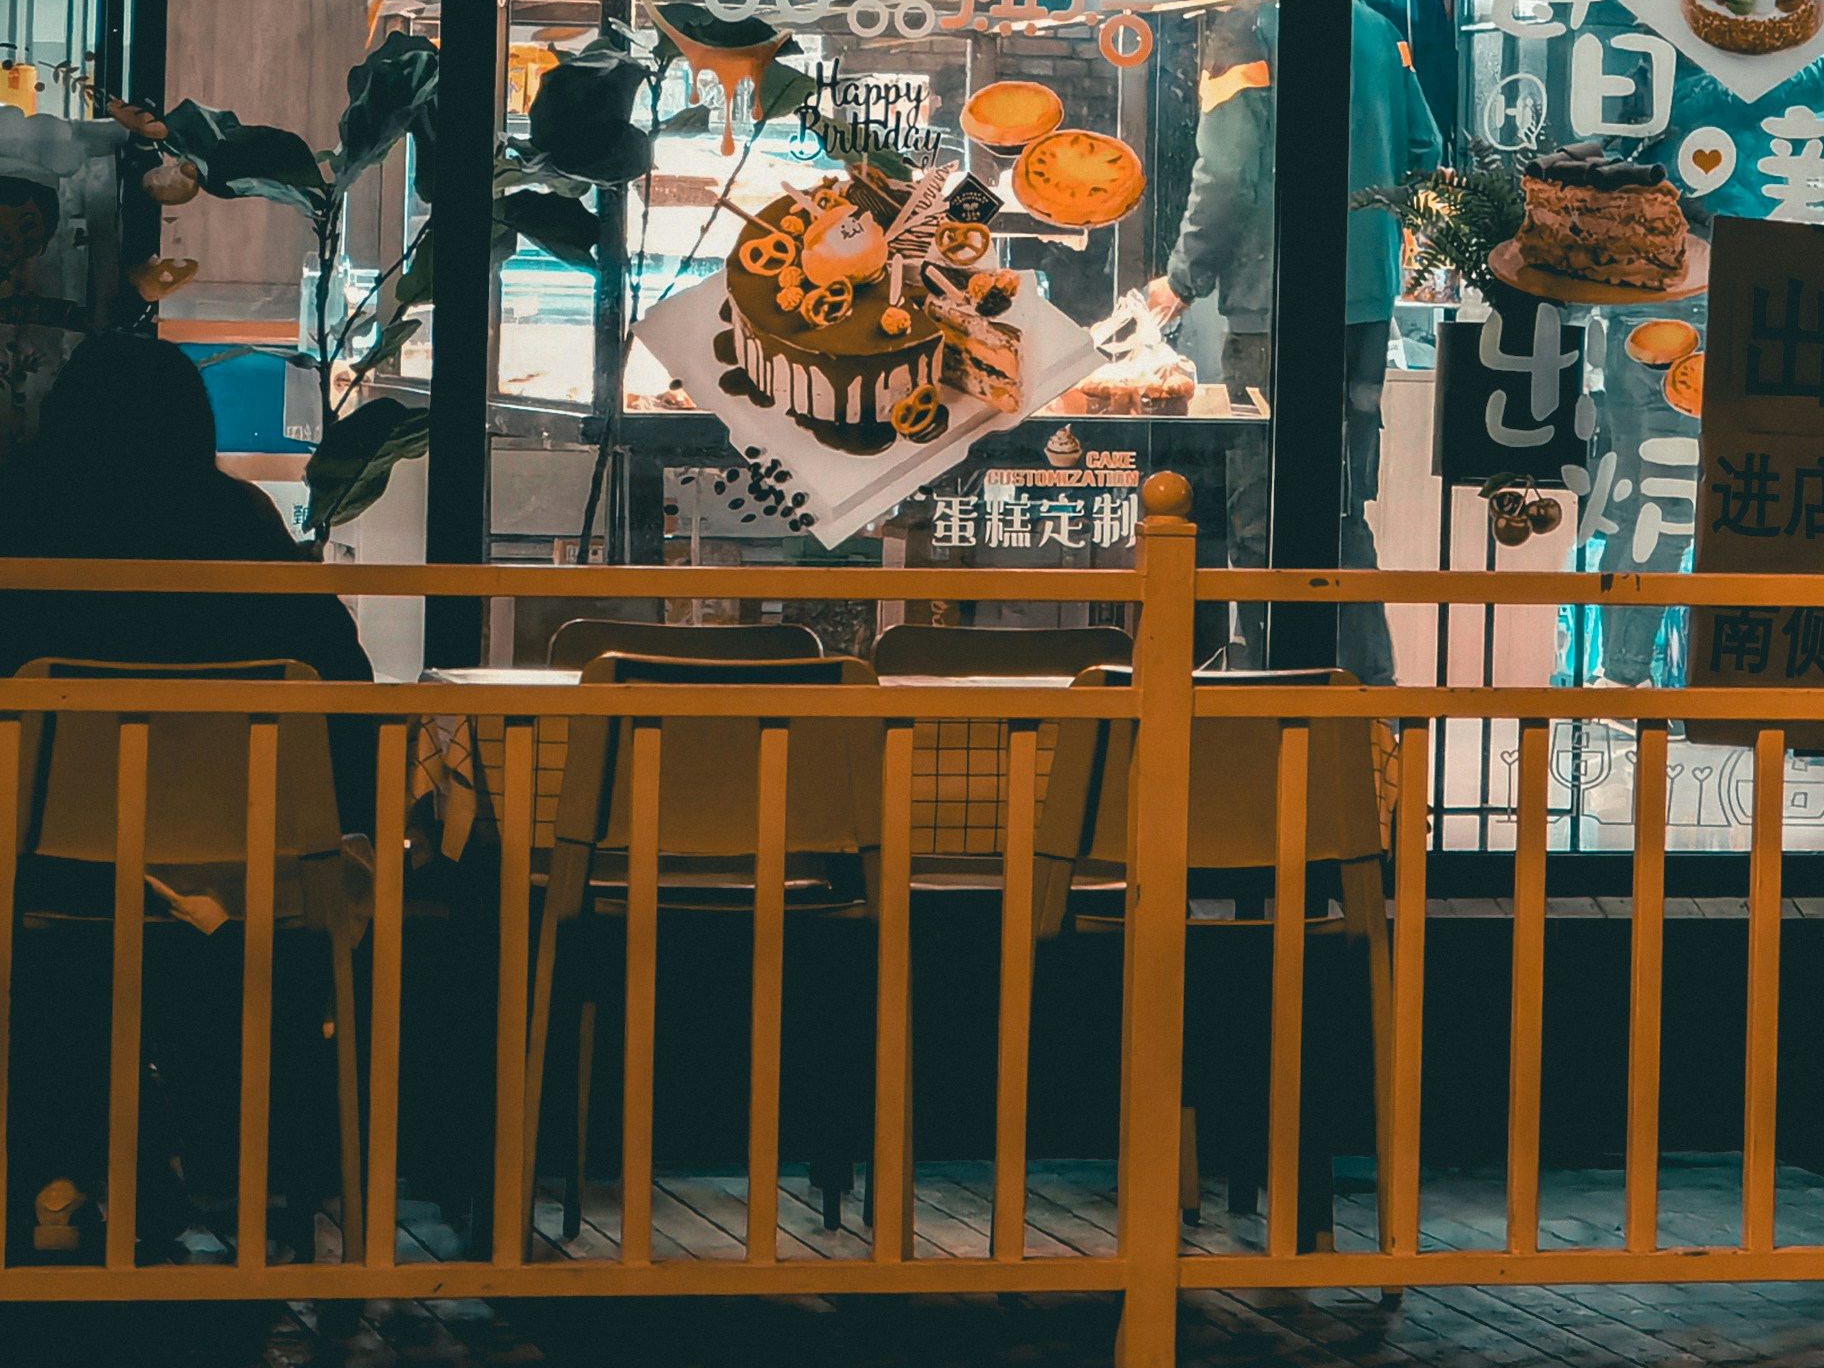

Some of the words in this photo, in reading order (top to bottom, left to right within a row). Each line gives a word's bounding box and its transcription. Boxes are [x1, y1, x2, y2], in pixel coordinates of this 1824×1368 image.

[814, 57, 930, 130] Happy
[789, 92, 941, 170] Birthday
[986, 469, 1139, 487] CUSTOMIZATION
[1086, 451, 1137, 469] CAKE
[932, 492, 1139, 549] 蛋糕定制
